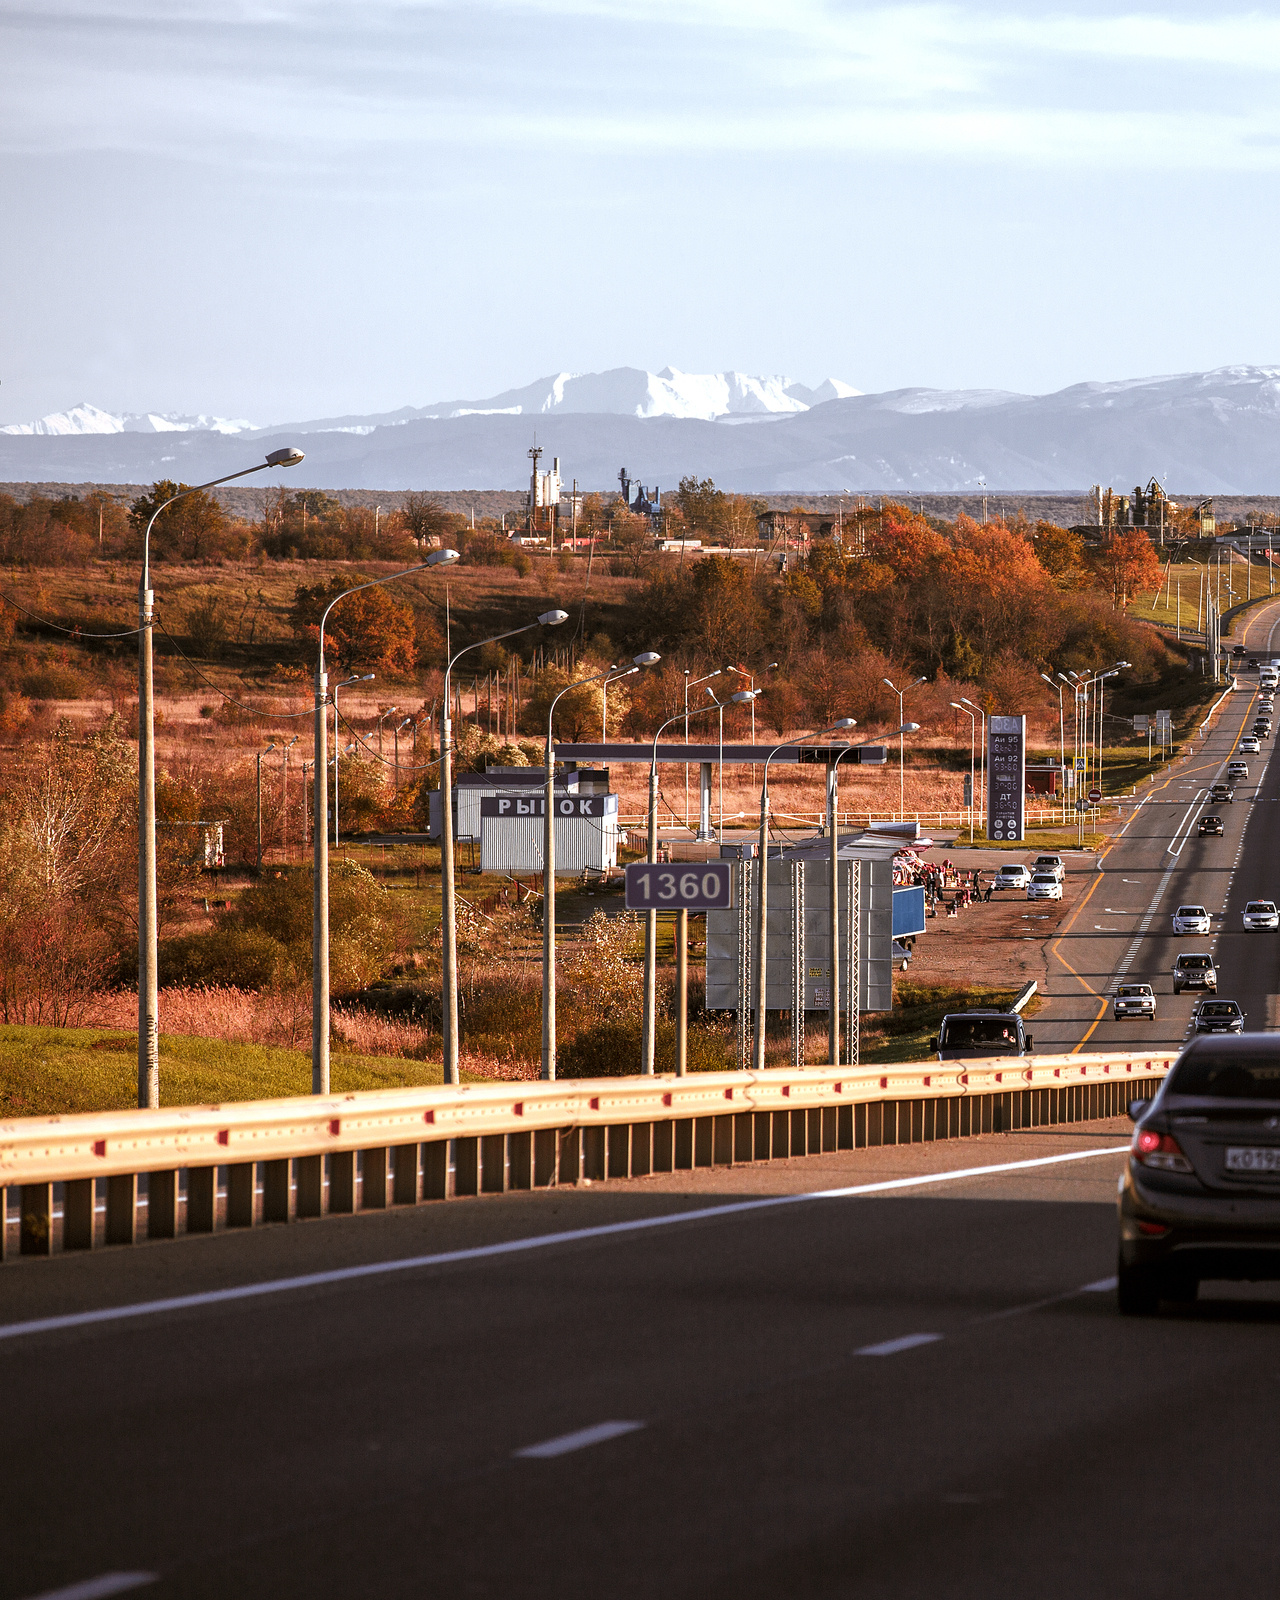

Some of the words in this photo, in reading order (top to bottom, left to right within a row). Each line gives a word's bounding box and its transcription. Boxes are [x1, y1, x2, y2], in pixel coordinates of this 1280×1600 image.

[999, 793, 1012, 801] ДТ
[498, 799, 593, 815] РЫОК
[636, 872, 721, 900] 1360
